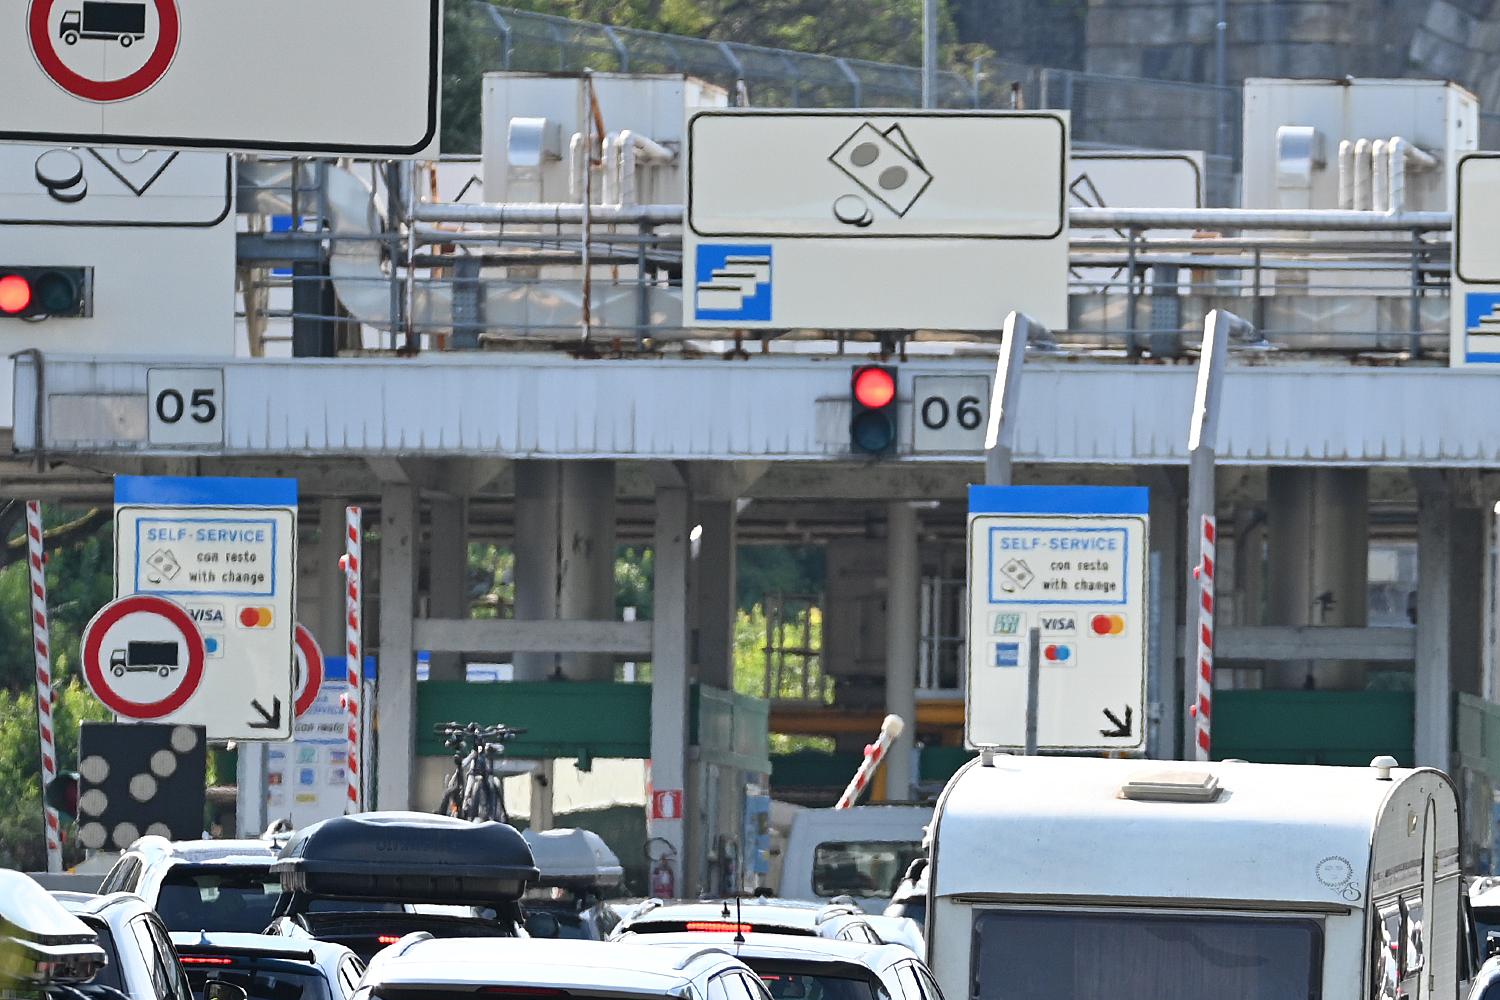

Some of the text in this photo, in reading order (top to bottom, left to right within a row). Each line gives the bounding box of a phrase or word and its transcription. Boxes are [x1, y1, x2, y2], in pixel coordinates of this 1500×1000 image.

[156, 389, 216, 424] 05
[922, 396, 982, 430] 06
[197, 551, 257, 562] con resto
[1050, 560, 1108, 571] con resto
[189, 571, 264, 584] with change
[1043, 579, 1116, 592] with change
[190, 609, 223, 621] VISA
[1042, 618, 1075, 630] VISA
